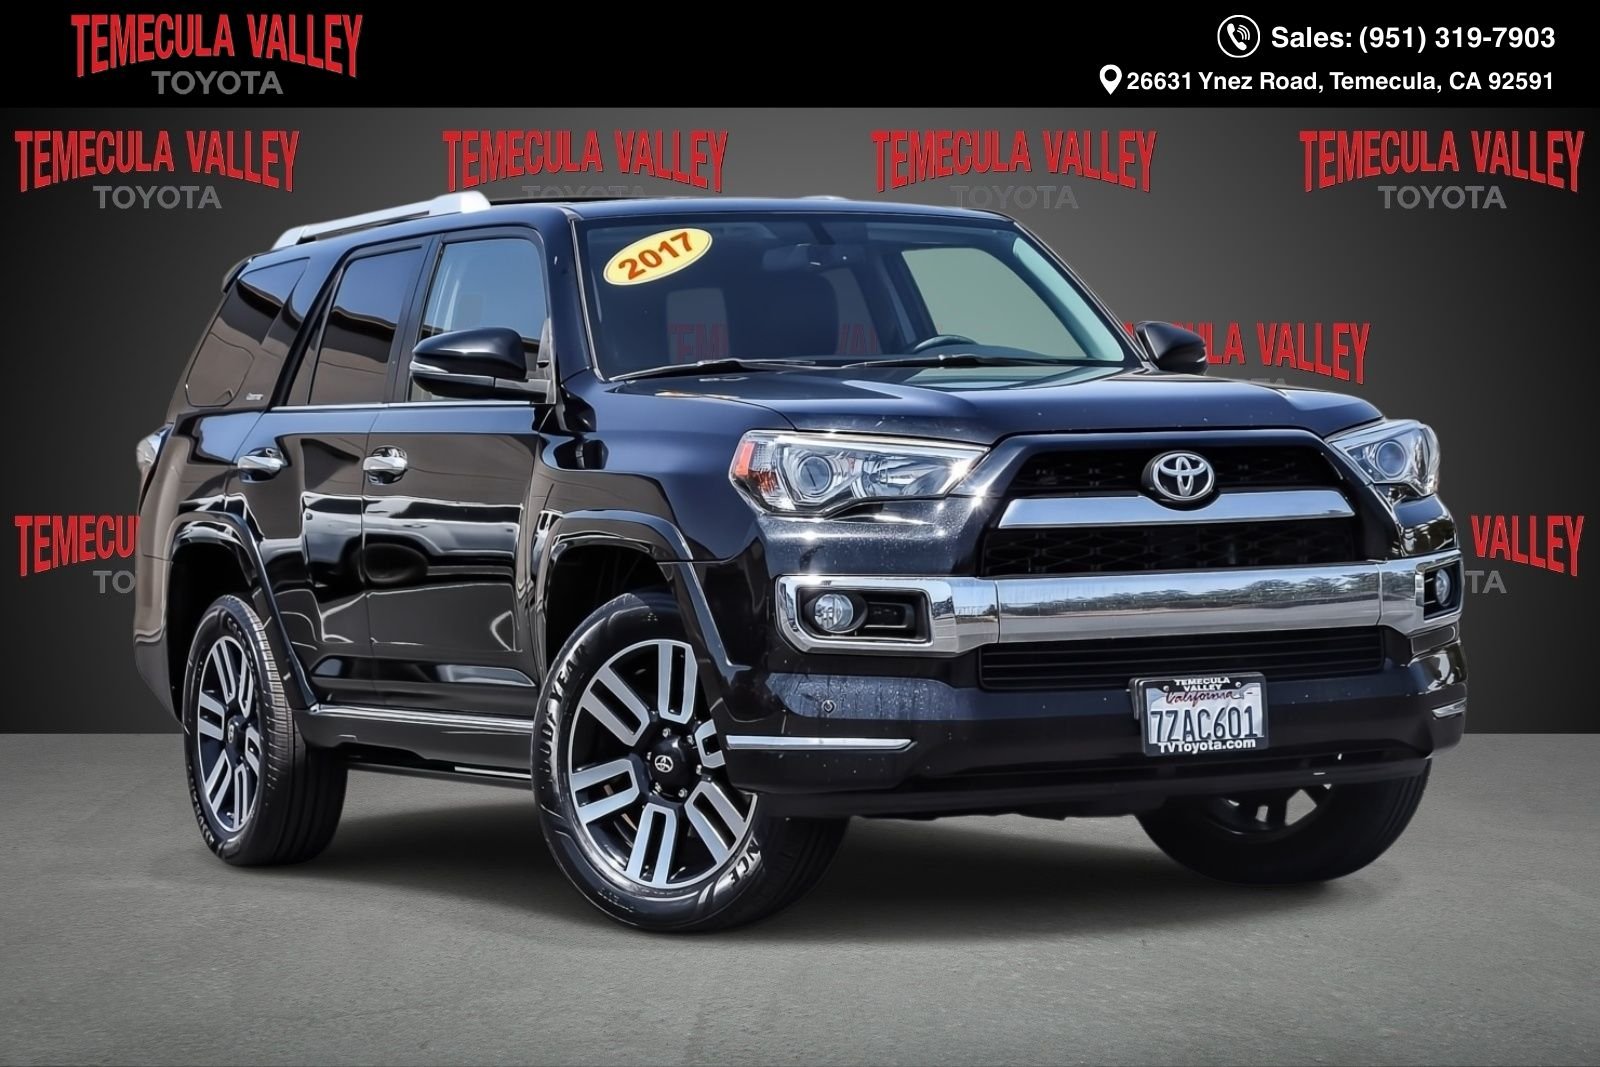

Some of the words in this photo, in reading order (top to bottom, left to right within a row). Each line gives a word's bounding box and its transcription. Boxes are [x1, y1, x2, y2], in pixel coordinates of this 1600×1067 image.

[15, 130, 174, 193] TEMECULA
[186, 130, 300, 193] VALLEY
[442, 130, 603, 193] TEMECULA
[614, 130, 729, 193] VALLEY
[871, 130, 1032, 193] TEMECULA
[1043, 130, 1158, 193] VALLEY
[1299, 130, 1460, 193] TEMECULA
[1471, 130, 1585, 193] VALLEY
[93, 185, 222, 209] TOYOTA
[950, 185, 1079, 209] TOYOTA
[1378, 185, 1507, 209] TOYOTA
[617, 232, 693, 281] 2017
[1257, 322, 1370, 385] VALLEY
[14, 515, 139, 577] TEMECU
[1471, 515, 1585, 577] VALLEY
[1165, 689, 1235, 707] California
[1173, 677, 1231, 687] TEMECULA
[1183, 683, 1224, 693] VALLEY
[1150, 705, 1258, 743] 7ZAC601
[1158, 738, 1256, 754] TVToyota.com
